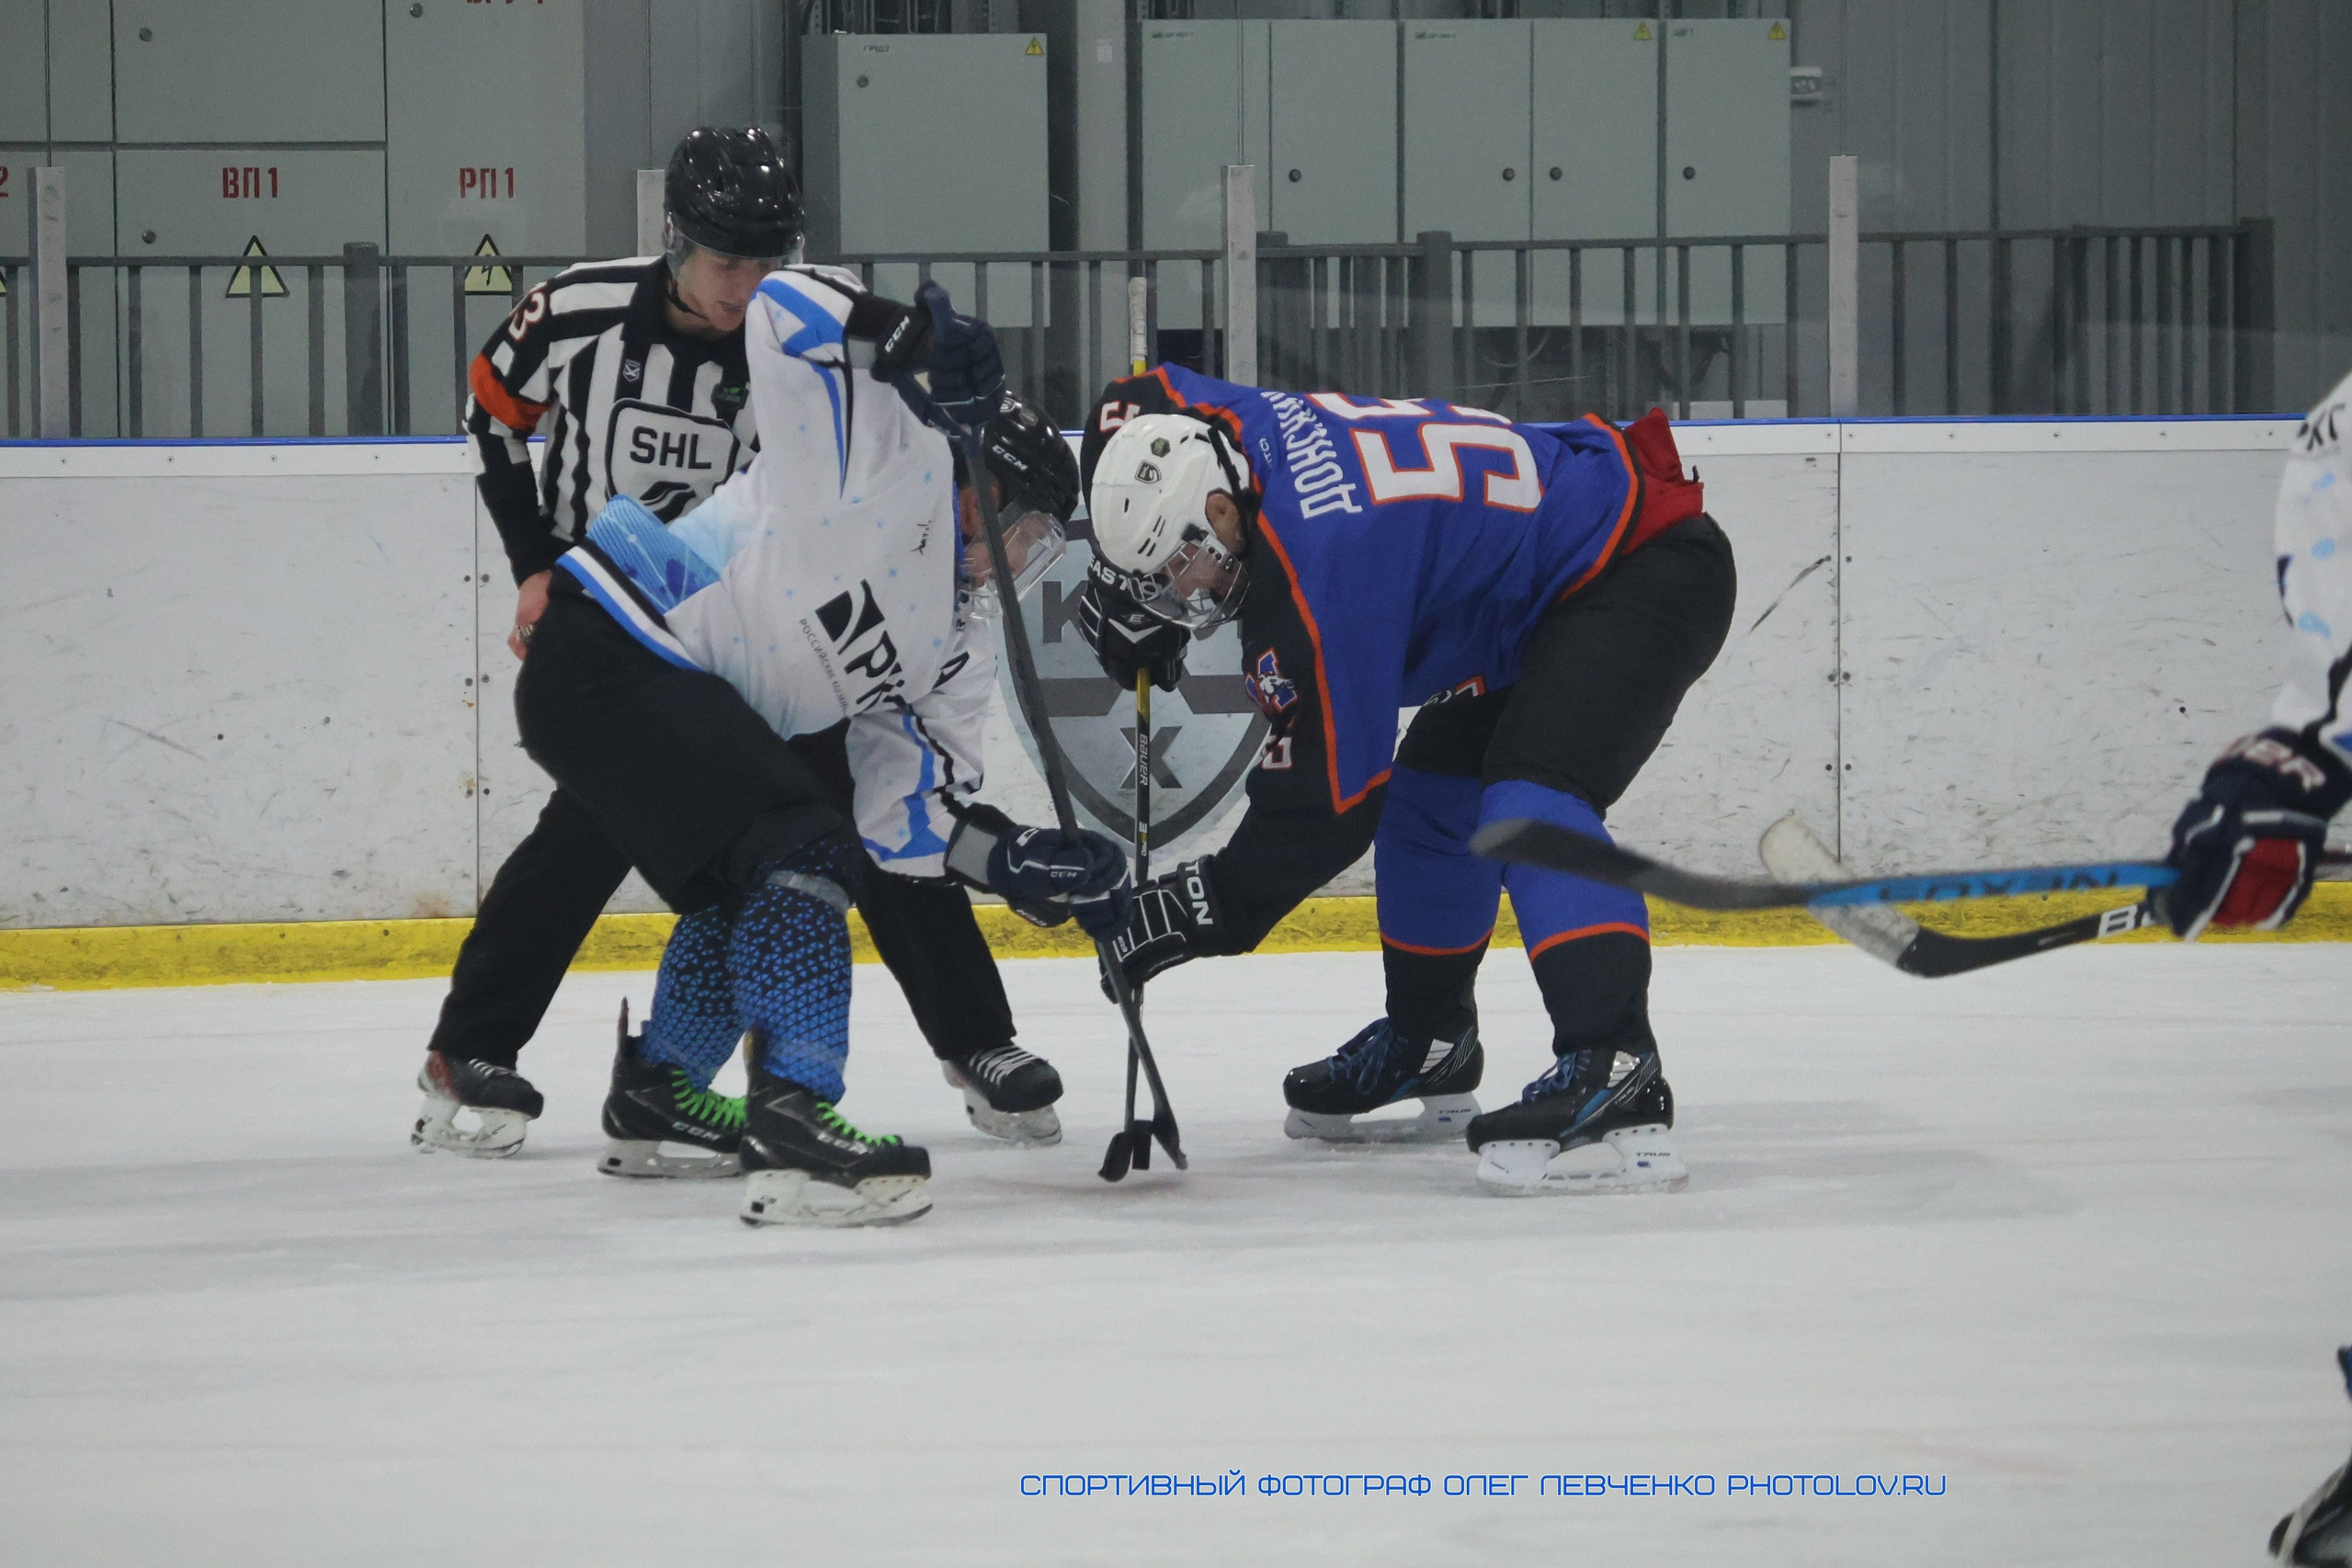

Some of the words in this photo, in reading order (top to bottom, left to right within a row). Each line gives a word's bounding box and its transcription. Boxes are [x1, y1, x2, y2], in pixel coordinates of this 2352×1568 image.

[884, 315, 910, 353] CCM
[630, 426, 712, 470] SHL
[992, 445, 1028, 471] CCM
[672, 1120, 721, 1142] CCM
